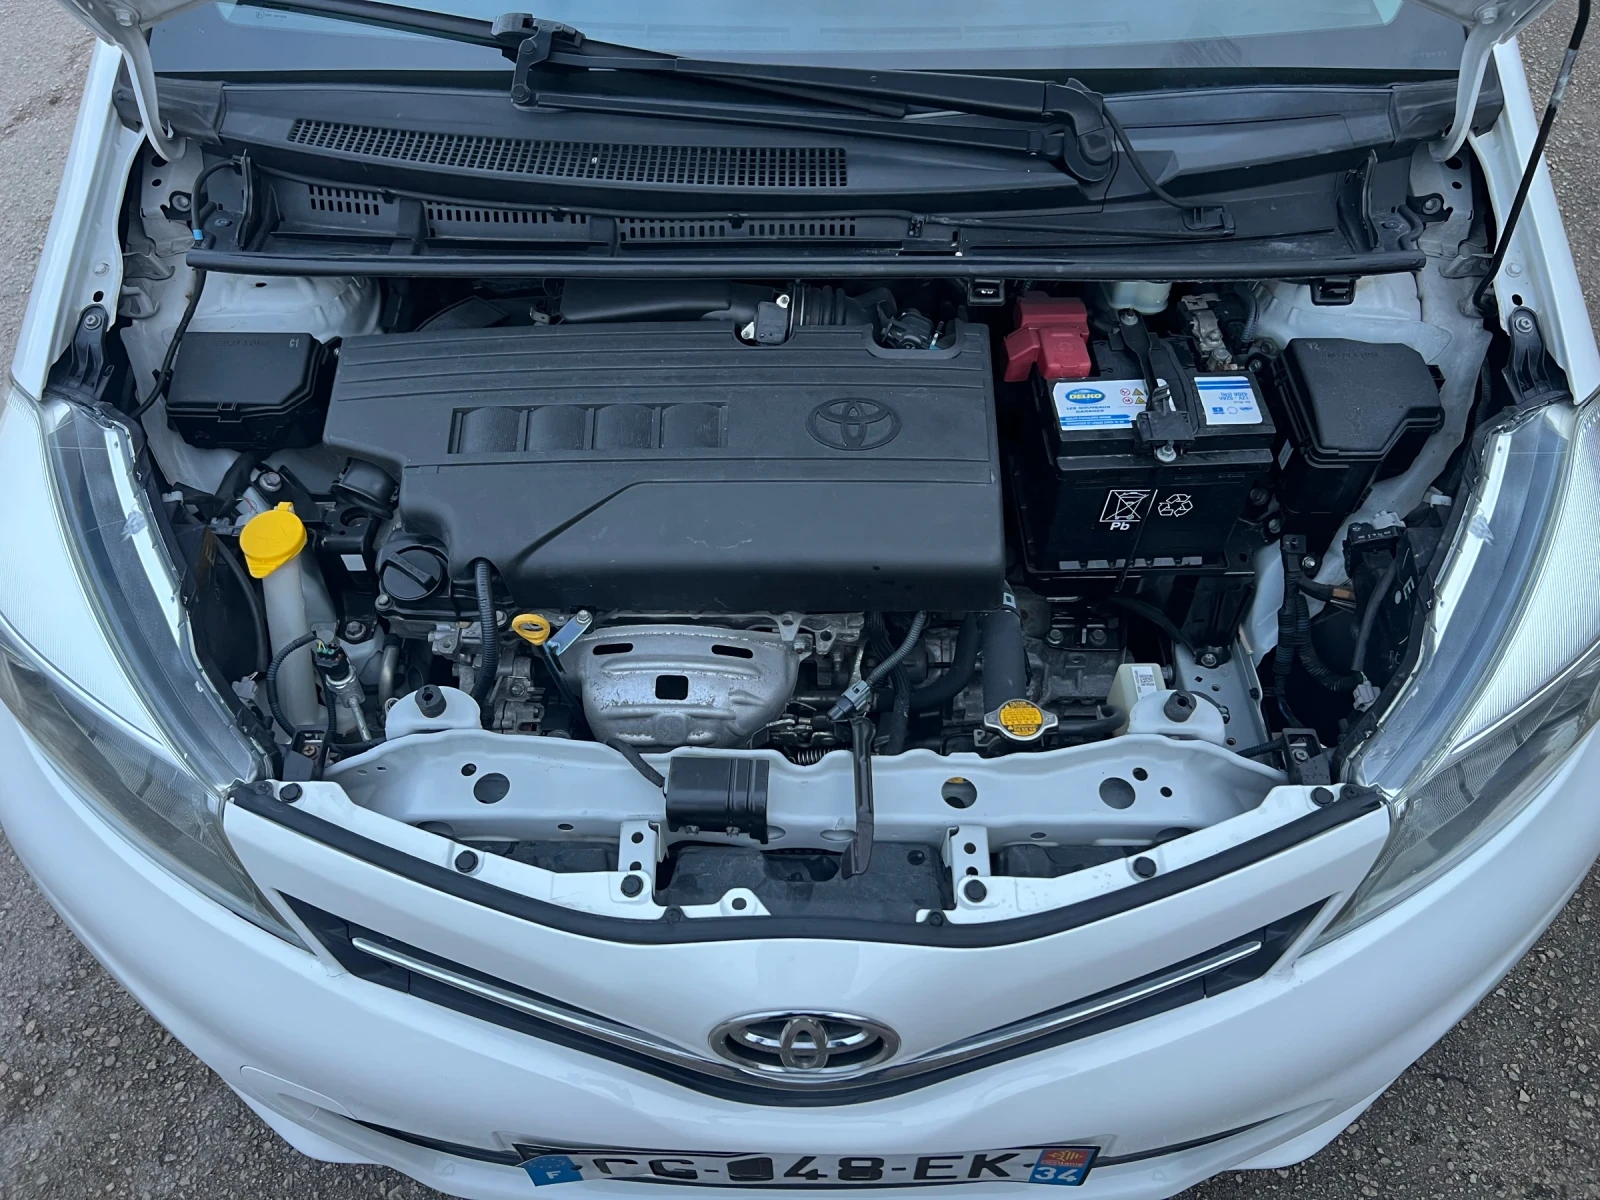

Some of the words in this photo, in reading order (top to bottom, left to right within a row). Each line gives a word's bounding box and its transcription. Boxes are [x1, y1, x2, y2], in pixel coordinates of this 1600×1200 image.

[1110, 521, 1130, 531] Pb
[545, 1171, 561, 1179] F
[1034, 1166, 1078, 1182] 34
